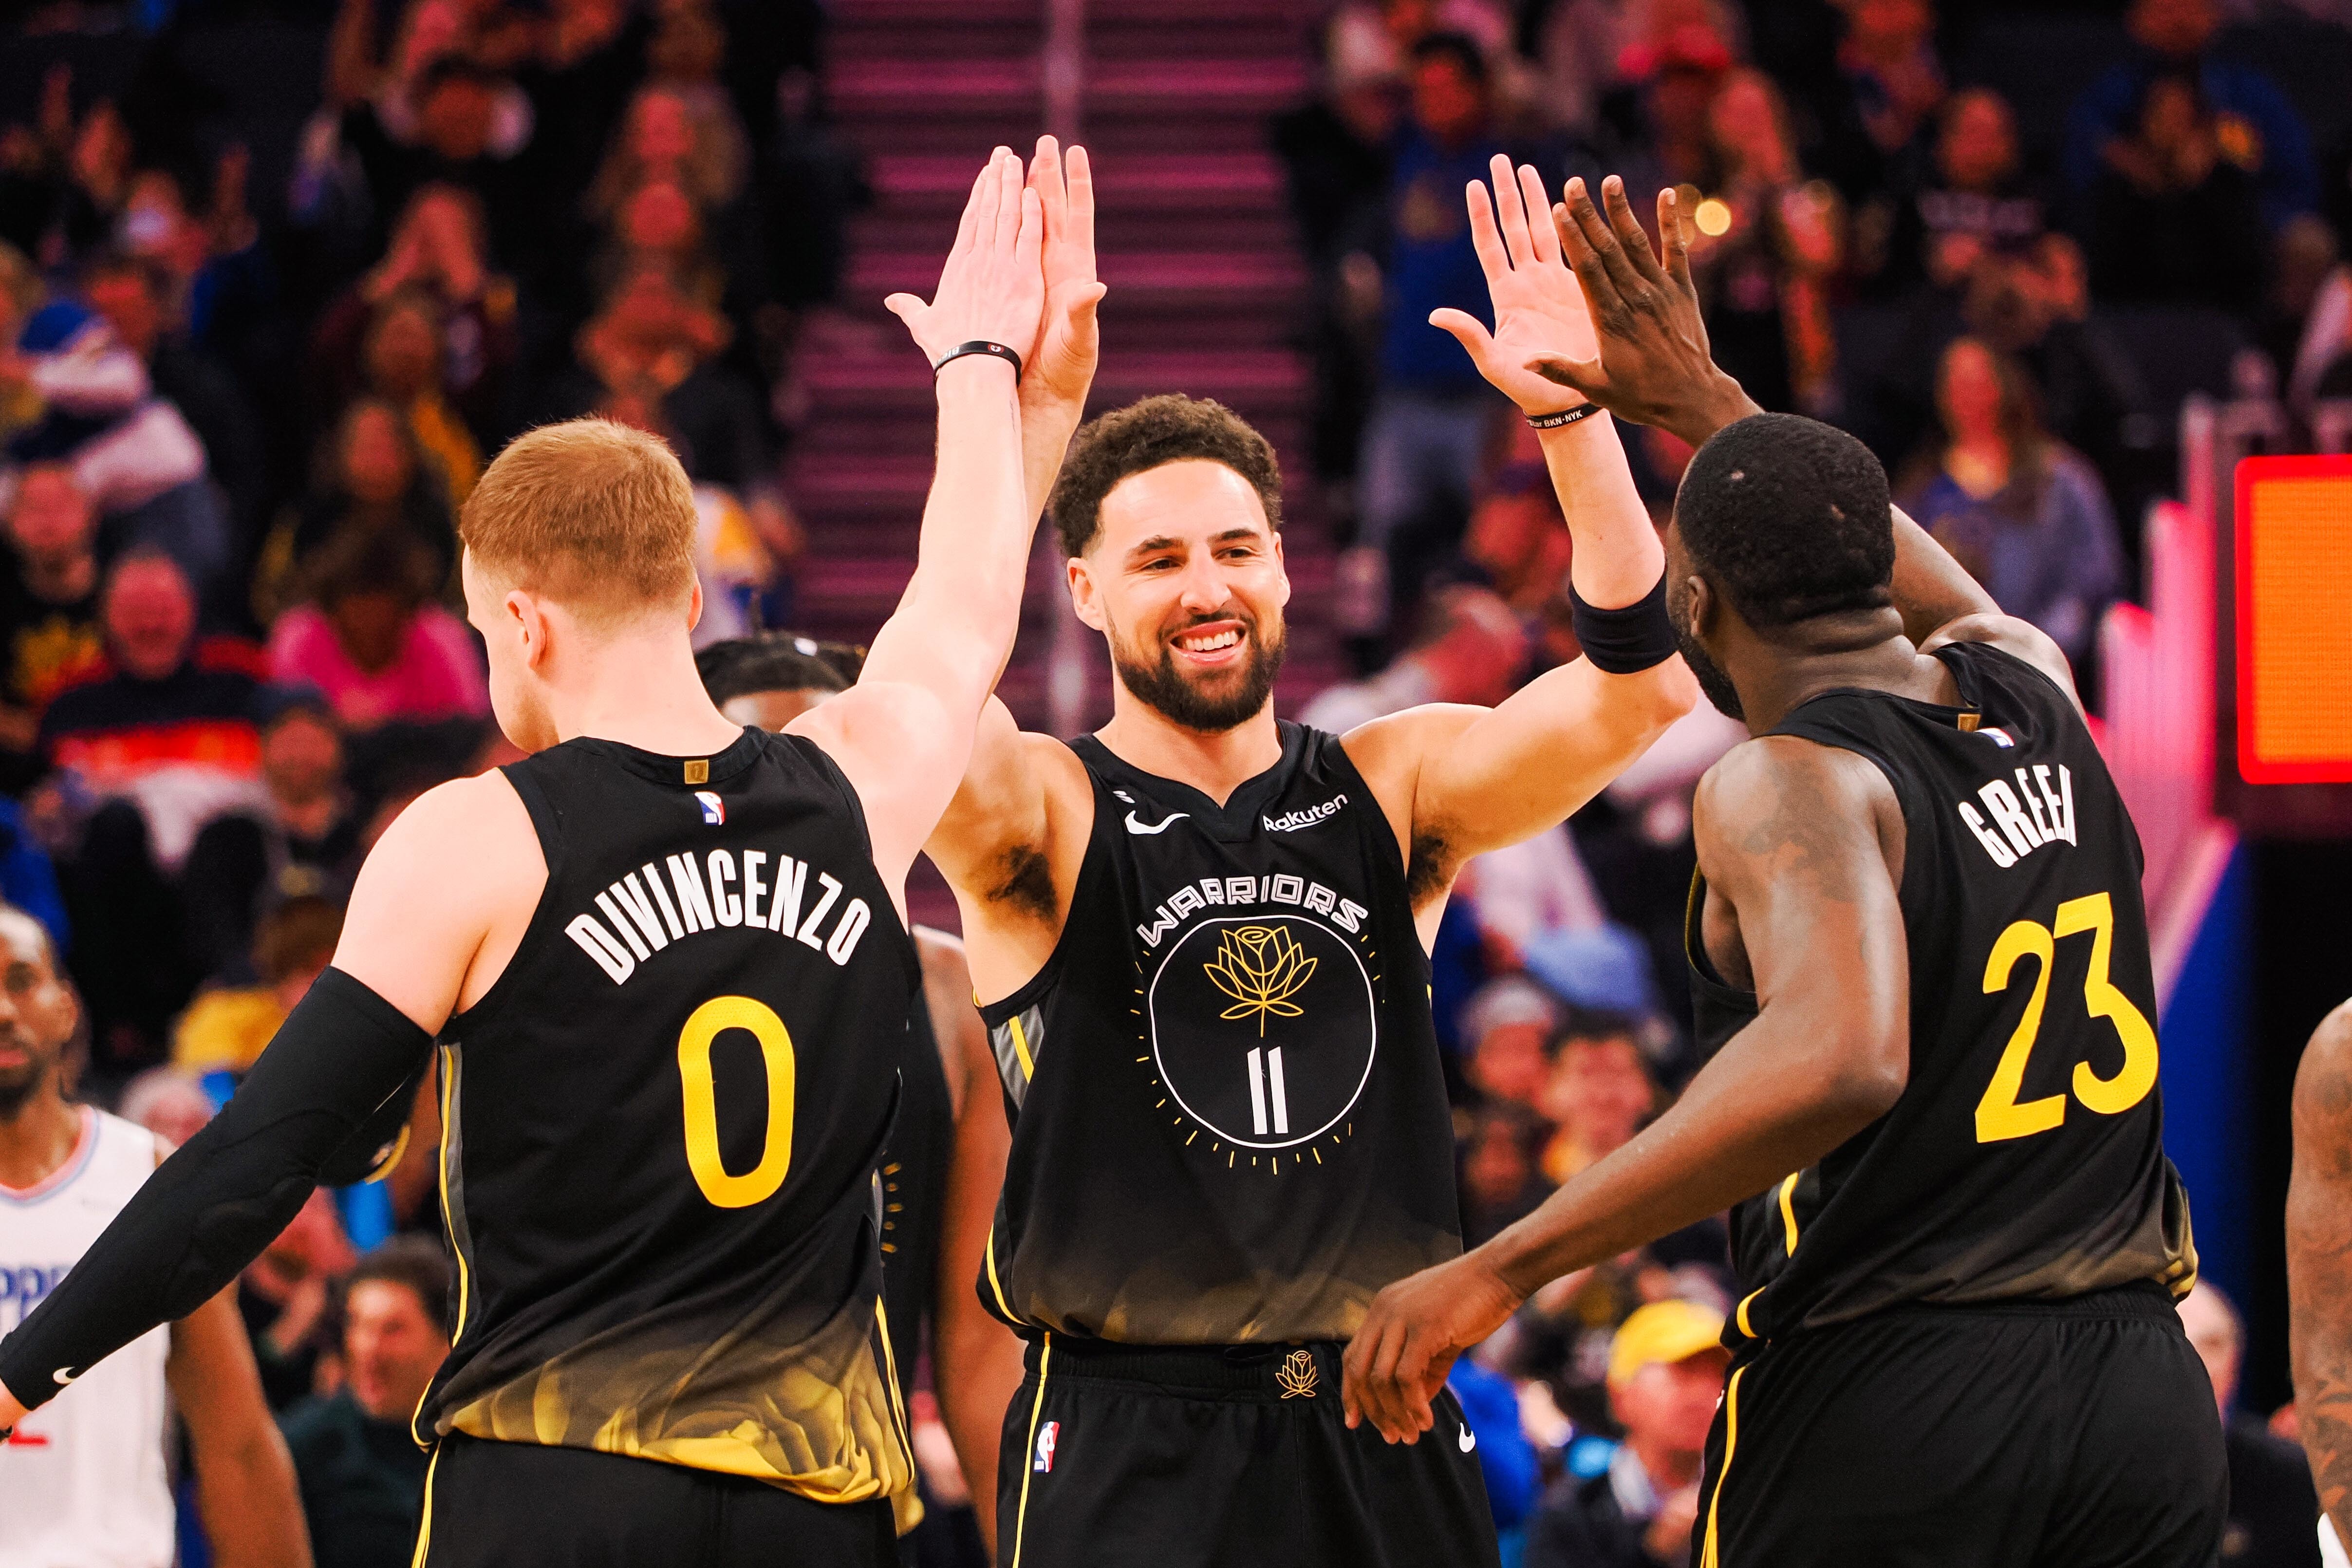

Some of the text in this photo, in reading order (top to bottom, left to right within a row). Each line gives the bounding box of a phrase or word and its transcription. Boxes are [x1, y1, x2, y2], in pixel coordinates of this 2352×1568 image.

[1263, 794, 1348, 832] Rakuten
[564, 849, 871, 986] DIVINCENZO
[1136, 874, 1369, 948] WARRIORS
[1975, 892, 2159, 1143] 23
[677, 995, 795, 1208] 0
[1247, 1046, 1289, 1135] 11
